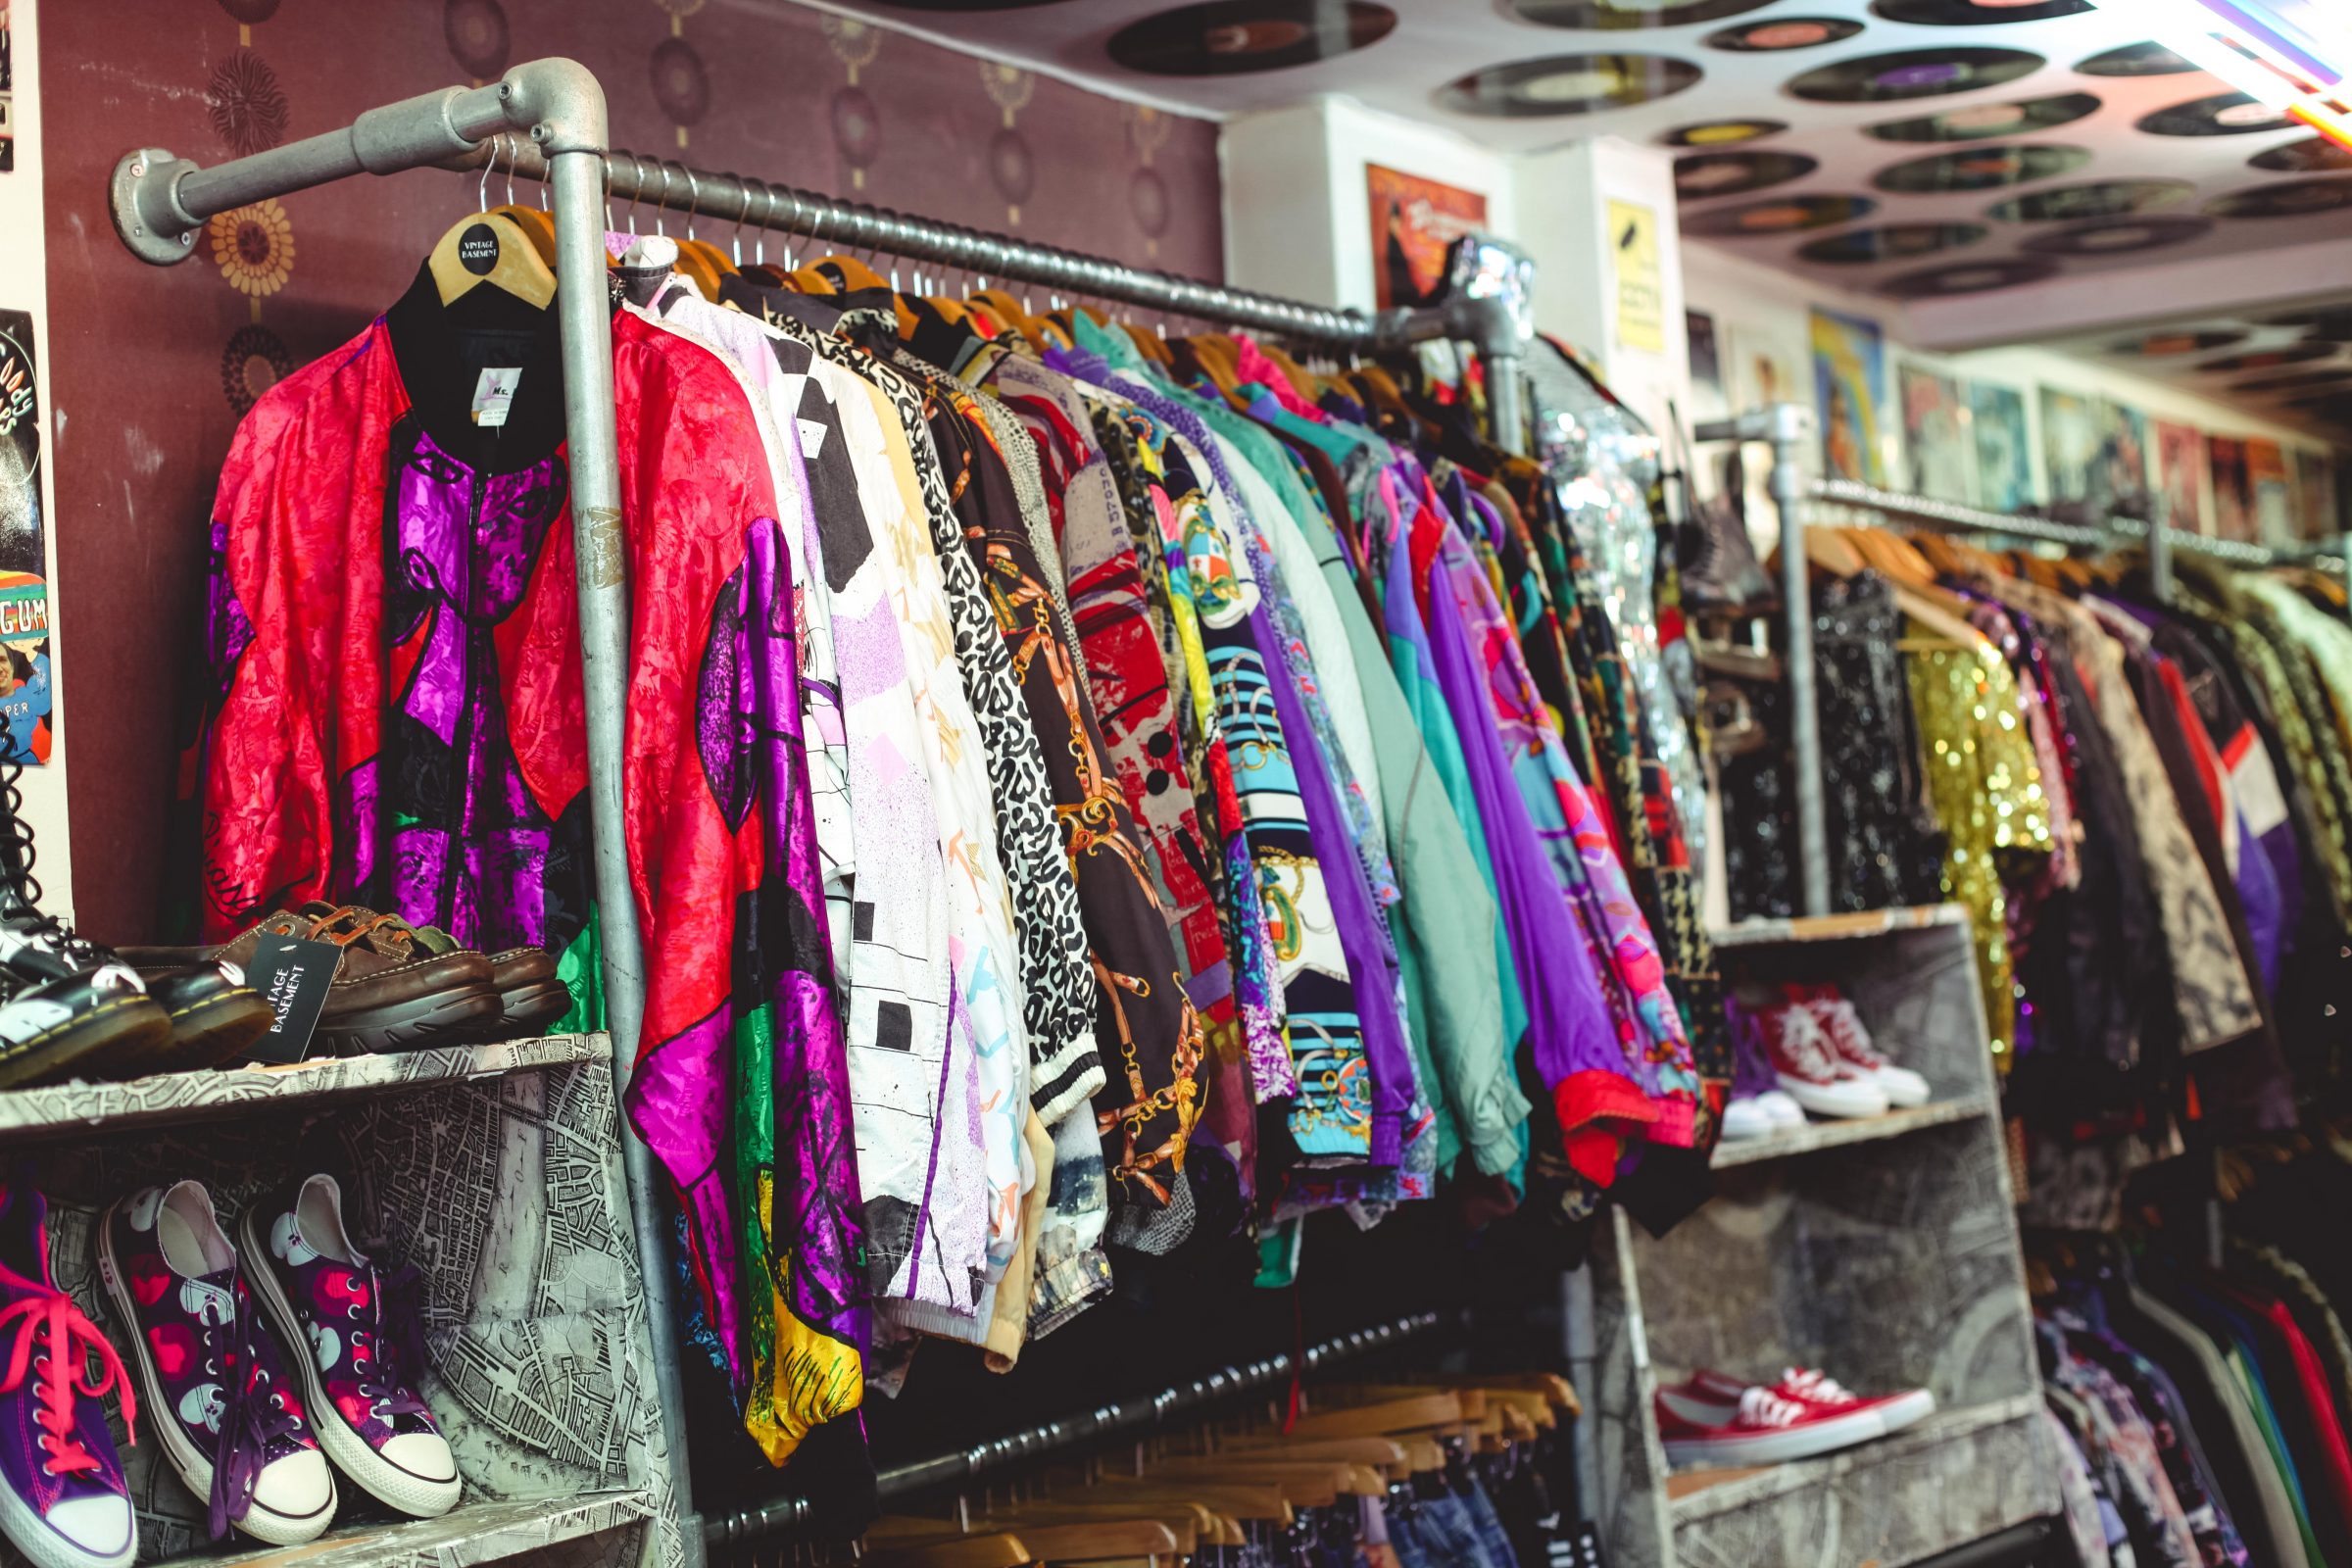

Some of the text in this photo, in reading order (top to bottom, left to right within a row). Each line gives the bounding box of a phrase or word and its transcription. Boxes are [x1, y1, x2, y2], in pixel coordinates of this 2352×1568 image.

[462, 249, 496, 259] BASEMENT
[0, 598, 48, 635] GUM
[270, 964, 305, 1033] BASEMENT
